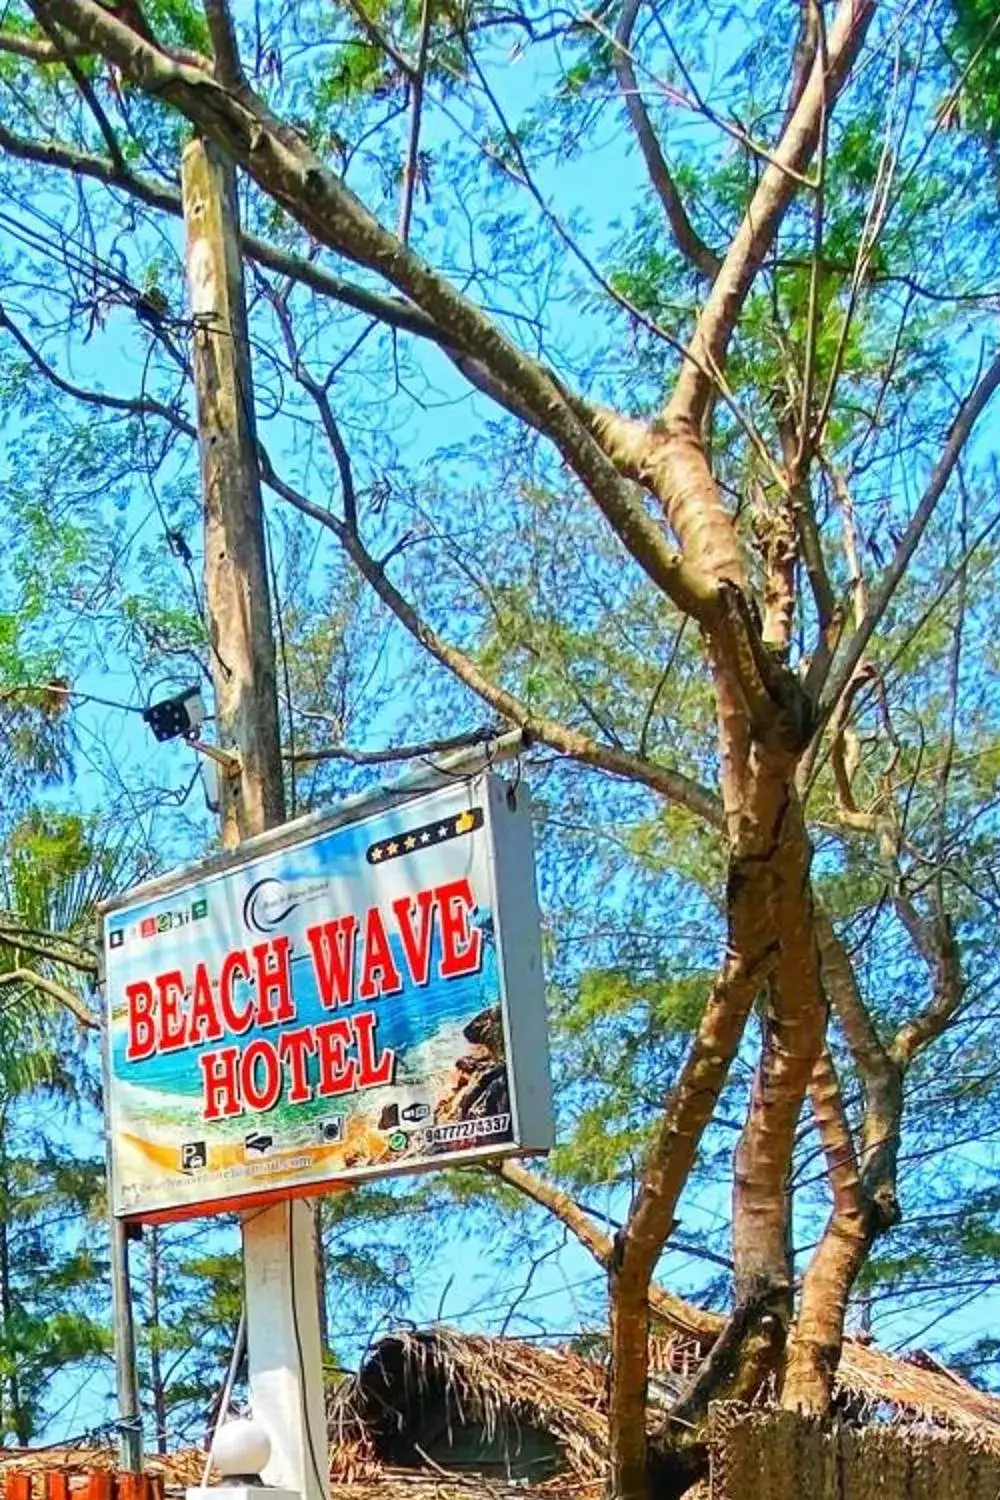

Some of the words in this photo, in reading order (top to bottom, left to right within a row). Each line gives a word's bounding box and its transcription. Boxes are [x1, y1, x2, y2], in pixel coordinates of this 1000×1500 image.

[125, 937, 296, 1058] BEACH
[307, 879, 480, 1005] WAVE
[202, 1014, 391, 1118] HOTEL
